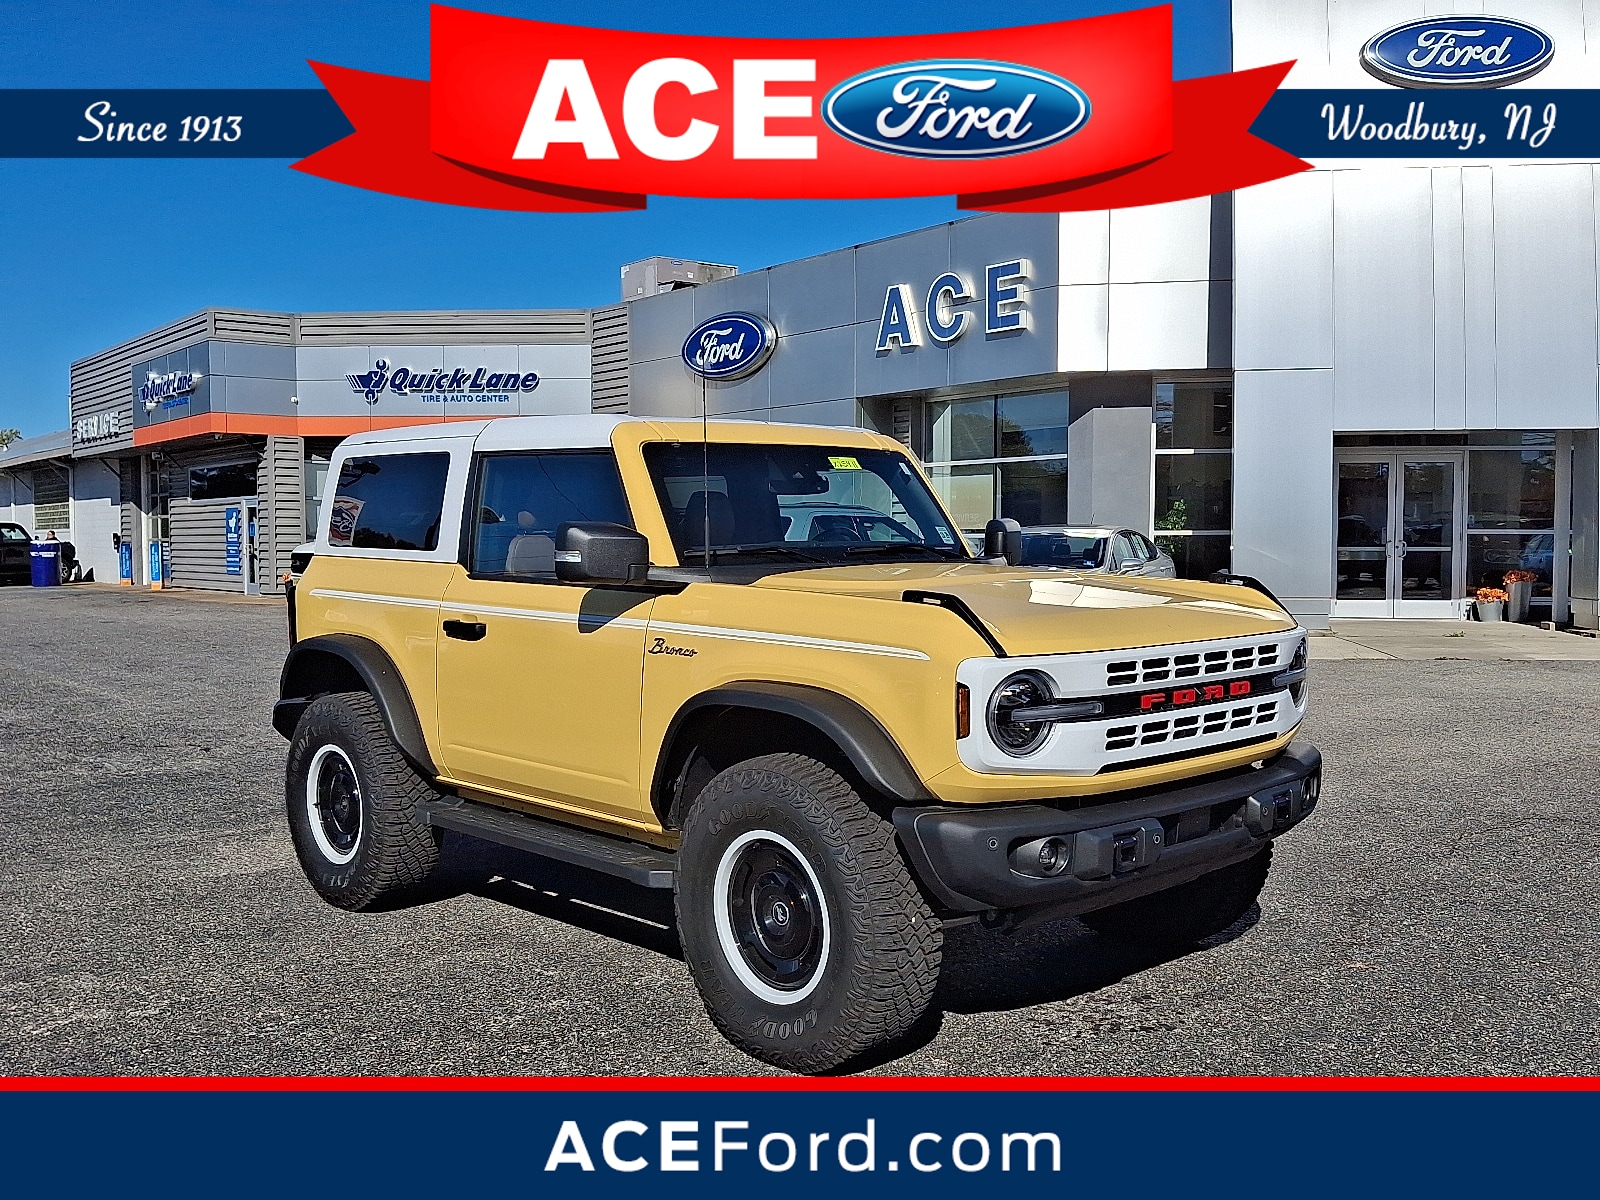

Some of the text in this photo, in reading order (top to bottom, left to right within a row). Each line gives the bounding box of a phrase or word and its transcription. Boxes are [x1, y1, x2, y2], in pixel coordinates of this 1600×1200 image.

[1406, 29, 1513, 68] Ford
[874, 258, 1029, 352] ACE
[696, 327, 746, 366] Ford
[149, 371, 193, 402] Quick Lane
[389, 367, 540, 393] Quick Lane
[421, 395, 442, 403] TIRE
[450, 395, 474, 403] AUTO
[475, 395, 510, 403] CENTER
[76, 411, 120, 439] SERVICE
[648, 638, 699, 657] Bronco
[1141, 681, 1251, 709] FORD
